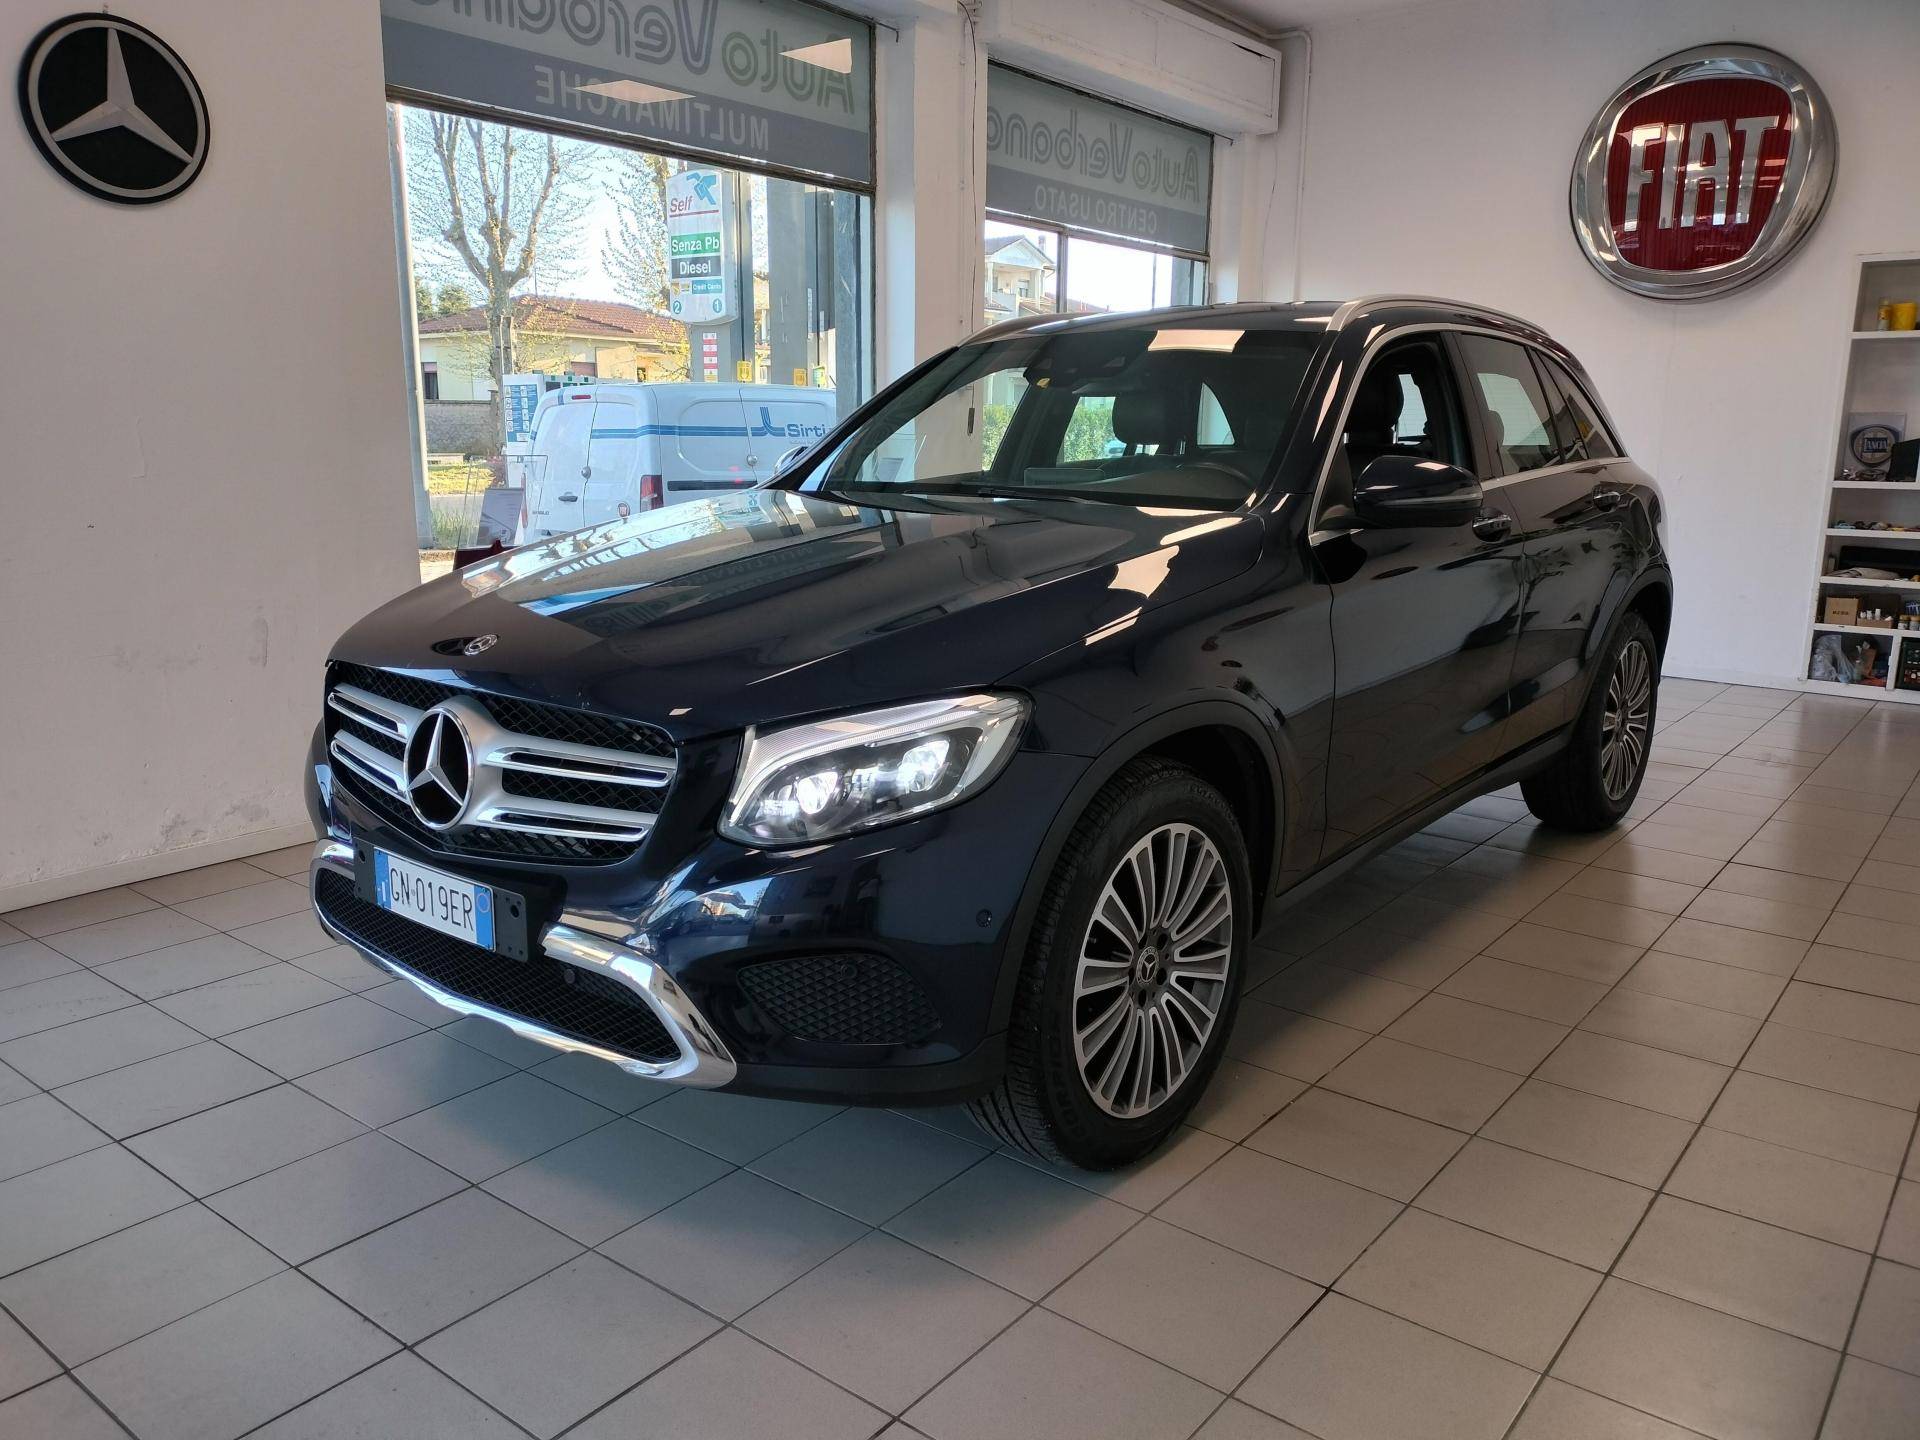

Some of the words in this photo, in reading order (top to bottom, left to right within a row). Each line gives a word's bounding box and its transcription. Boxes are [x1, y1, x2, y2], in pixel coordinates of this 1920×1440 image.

[1623, 115, 1780, 232] FIAT
[669, 195, 693, 213] Self
[671, 238, 702, 253] Senza
[705, 236, 721, 249] Pb
[679, 260, 712, 276] Diesel
[786, 424, 826, 437] Sirti
[390, 867, 410, 906] GN
[416, 877, 474, 932] 019ER
